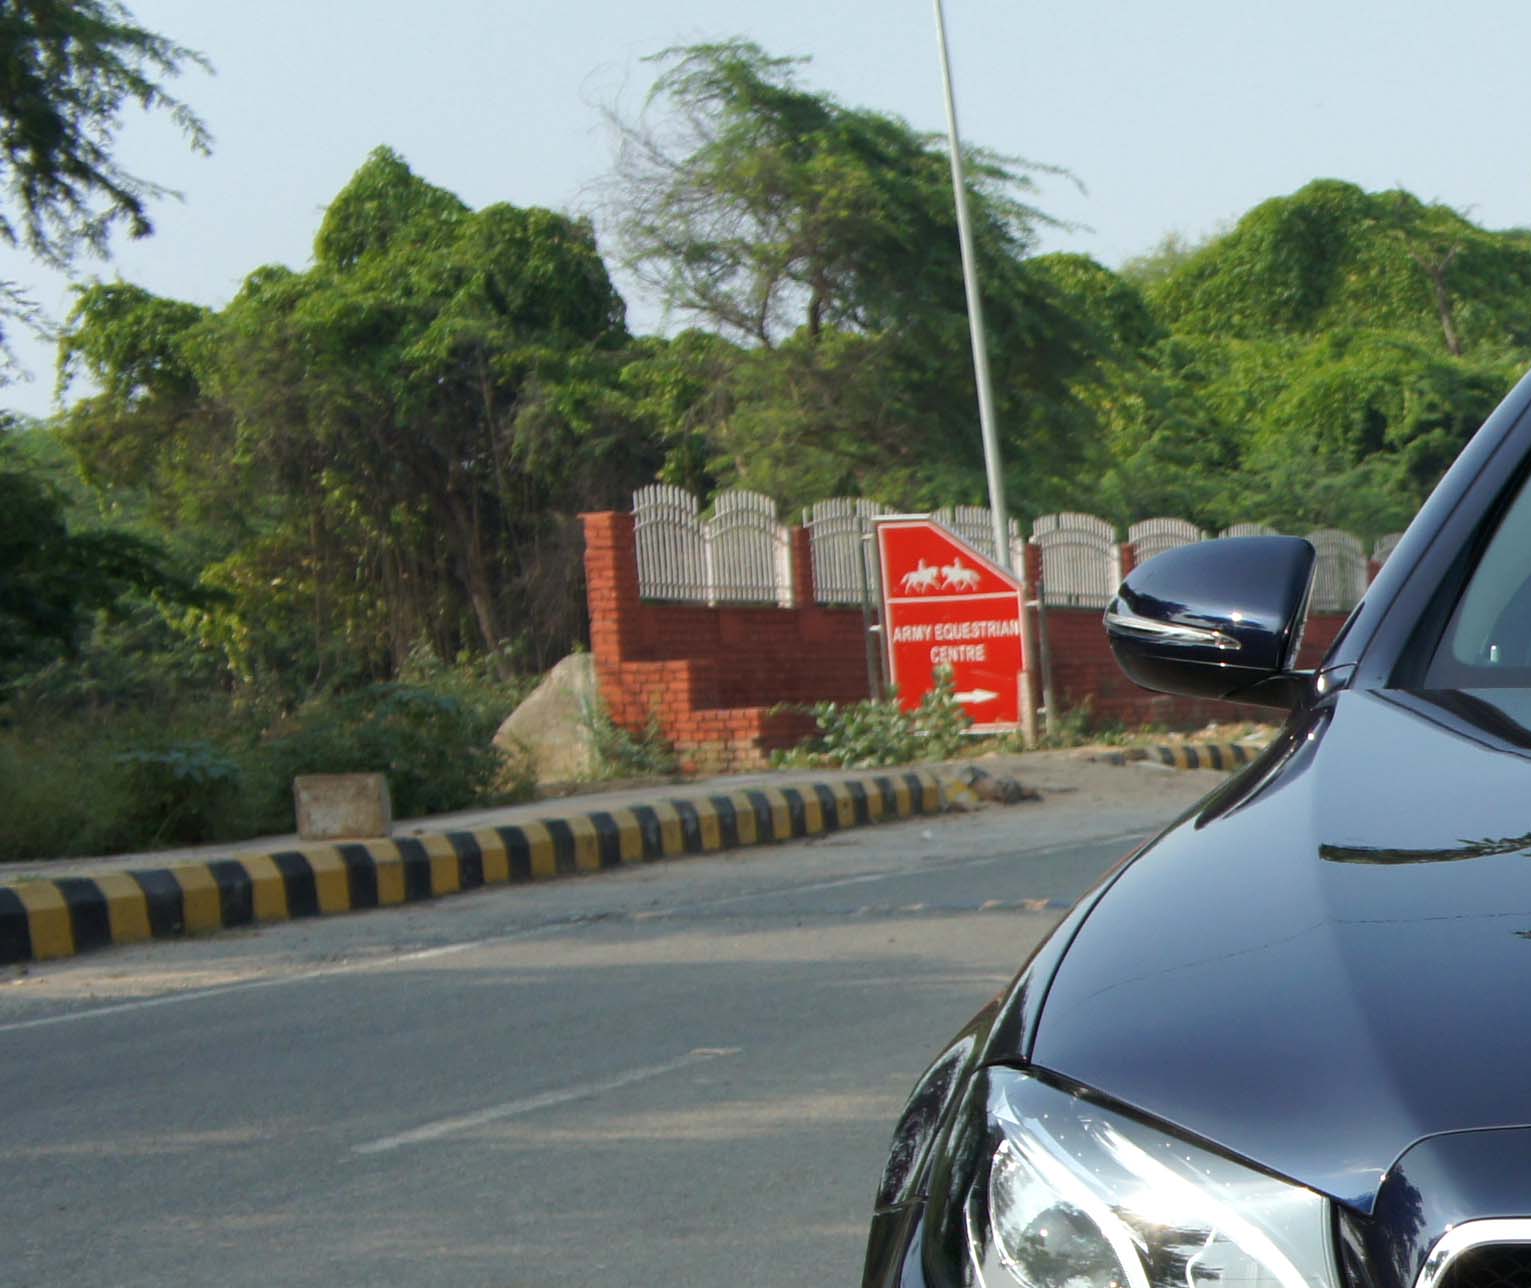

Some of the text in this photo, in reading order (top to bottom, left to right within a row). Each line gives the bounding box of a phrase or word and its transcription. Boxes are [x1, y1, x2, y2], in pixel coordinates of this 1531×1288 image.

[894, 620, 1020, 642] ARMY EQUESTRIAN
[930, 643, 986, 663] CENTRE
